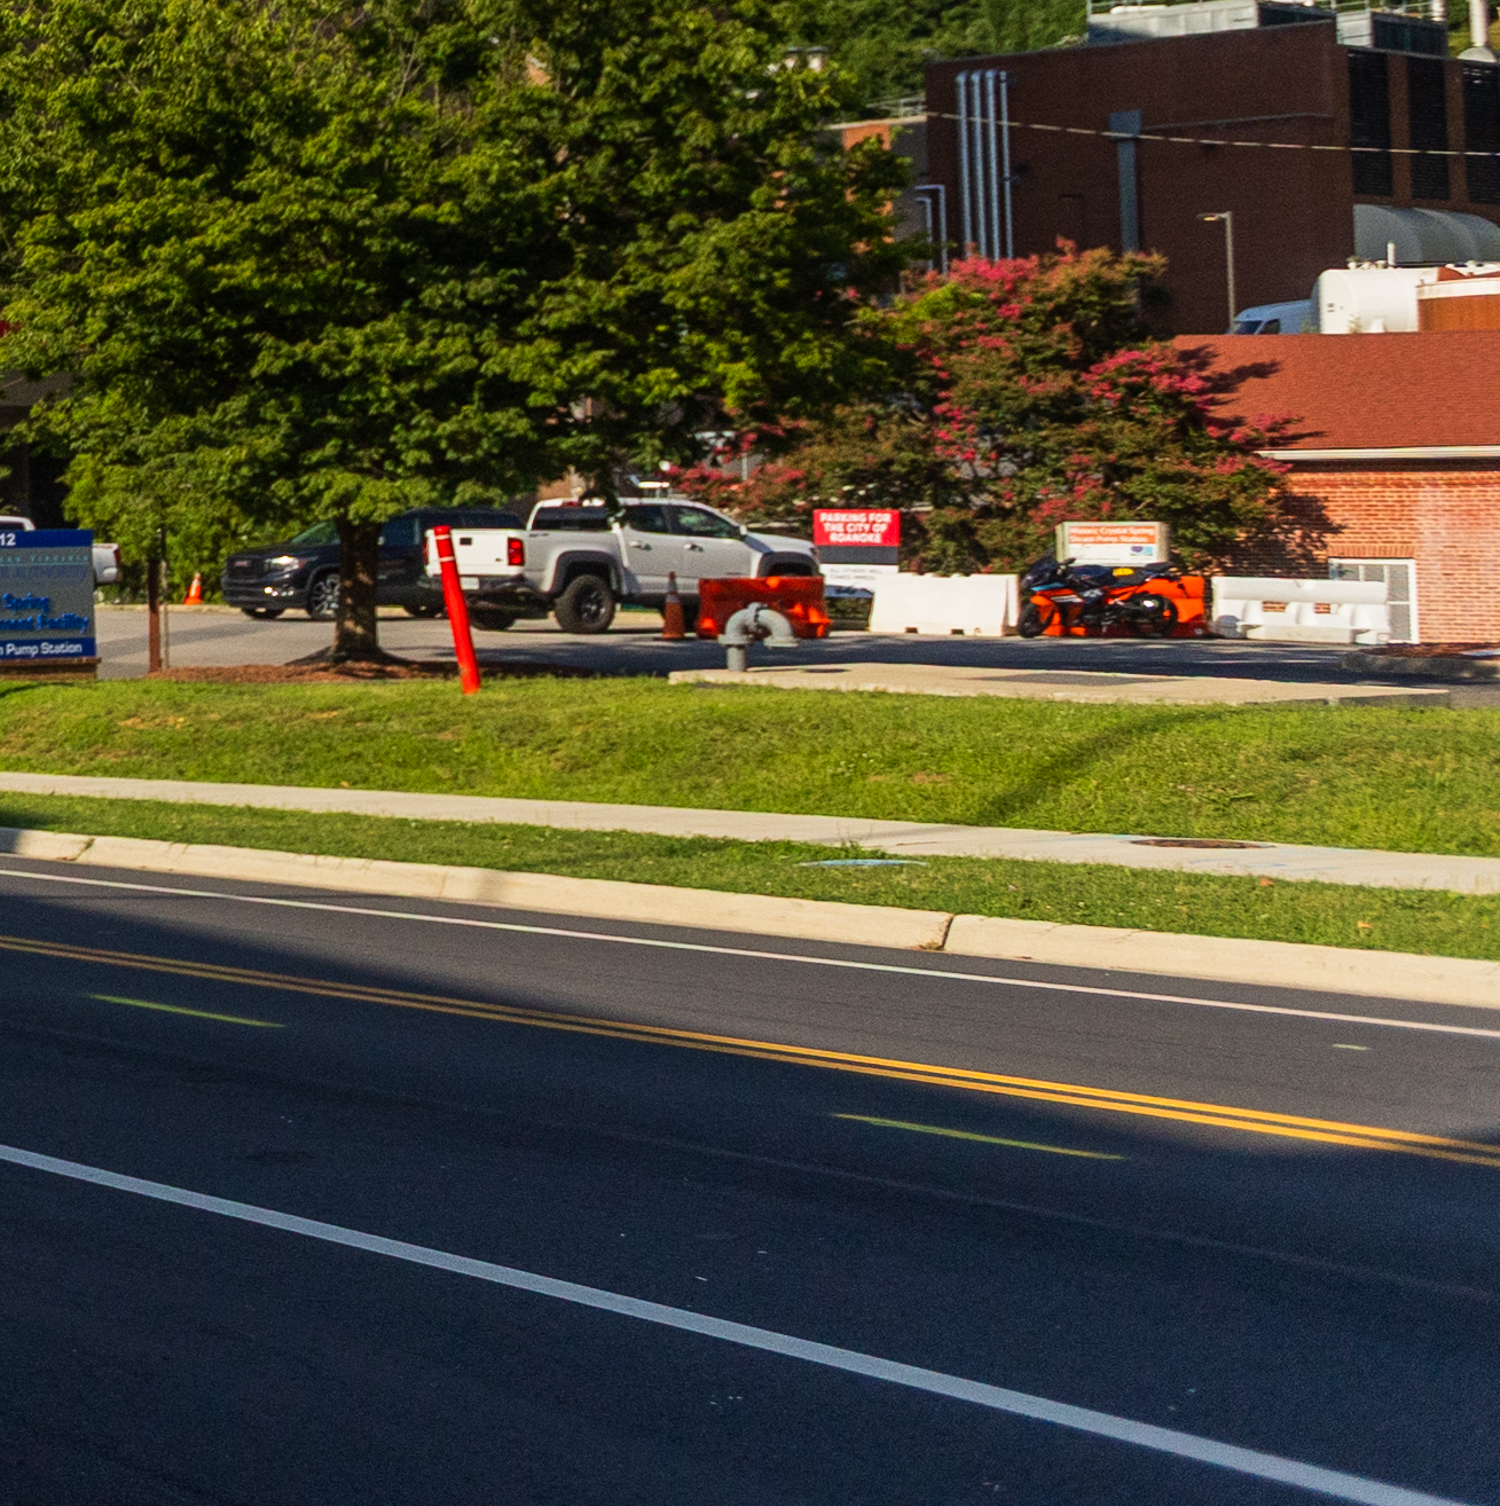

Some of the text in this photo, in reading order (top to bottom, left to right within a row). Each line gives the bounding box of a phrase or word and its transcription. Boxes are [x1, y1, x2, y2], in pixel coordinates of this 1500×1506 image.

[820, 512, 891, 523] PARKING FOR
[823, 522, 888, 532] THE CITY OF
[829, 532, 881, 543] ROANOKE
[3, 593, 50, 613] Spring
[37, 613, 89, 633] Facility
[6, 643, 39, 657] Pump
[41, 642, 82, 654] Station
